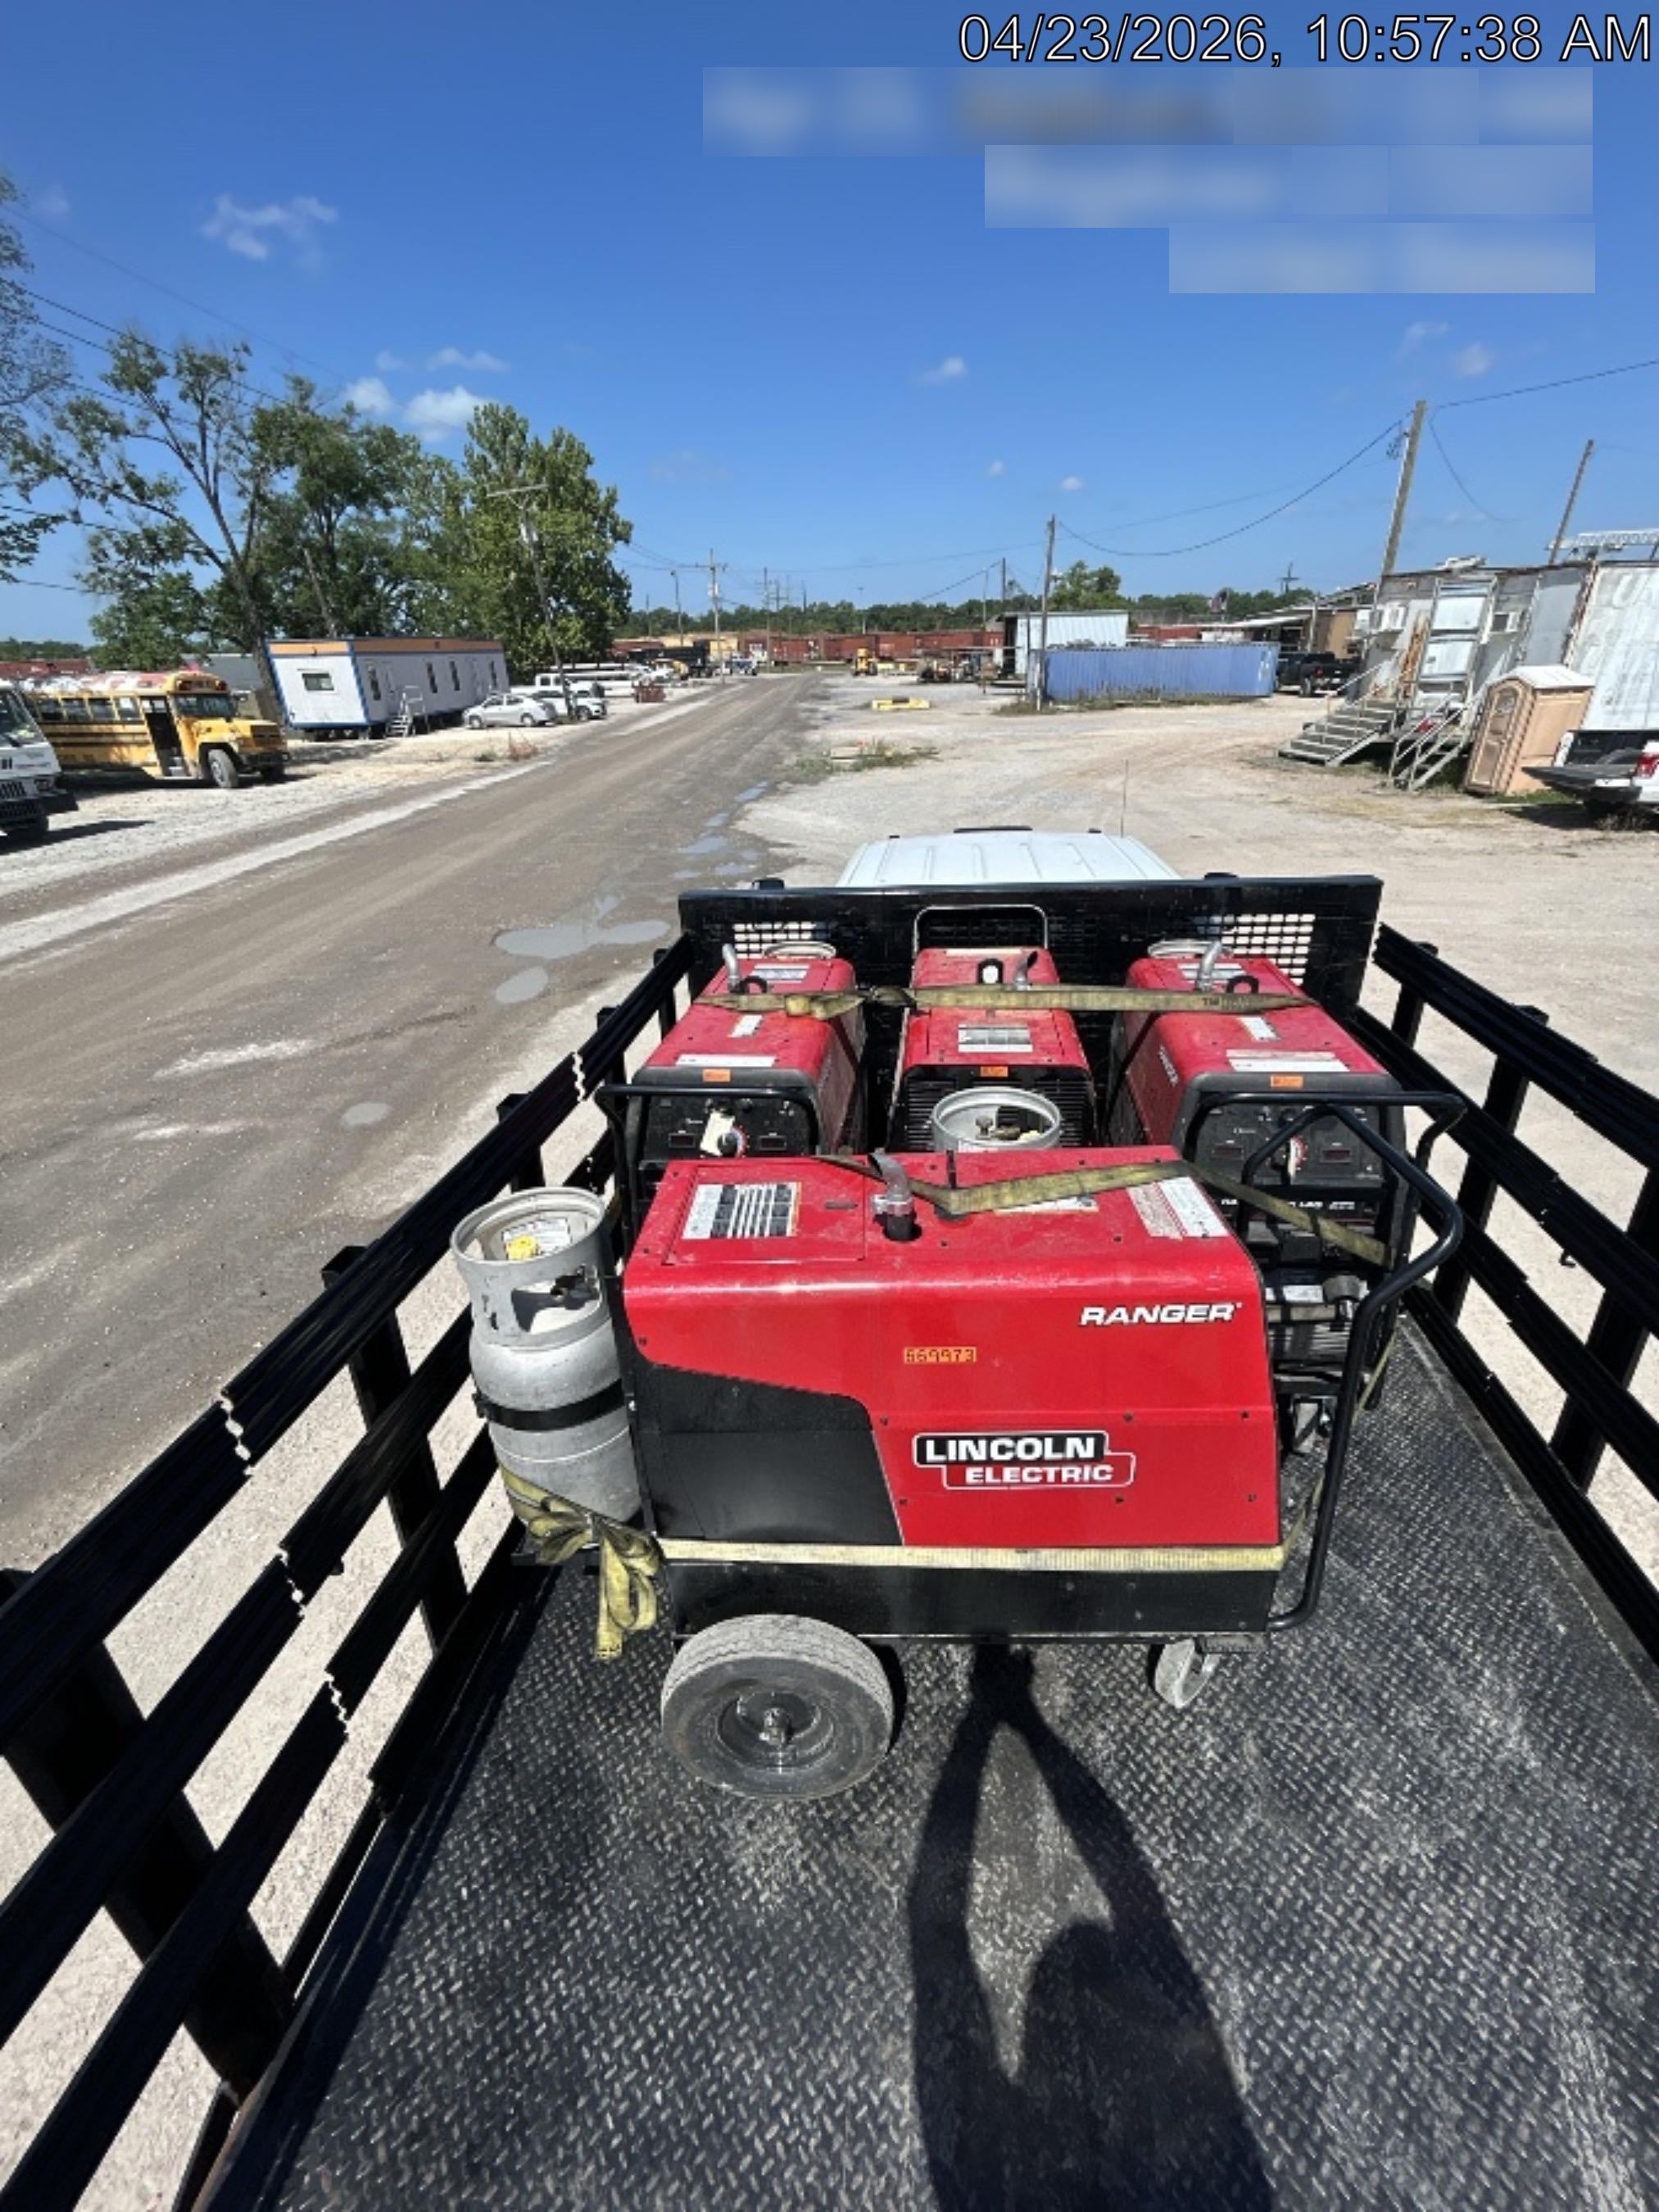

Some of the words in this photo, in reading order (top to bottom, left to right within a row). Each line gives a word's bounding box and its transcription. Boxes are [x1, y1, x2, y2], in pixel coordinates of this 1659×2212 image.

[1081, 1303, 1235, 1326] RANGER
[926, 1437, 1095, 1462] LINCOLN
[965, 1465, 1114, 1484] ELECTRIC
